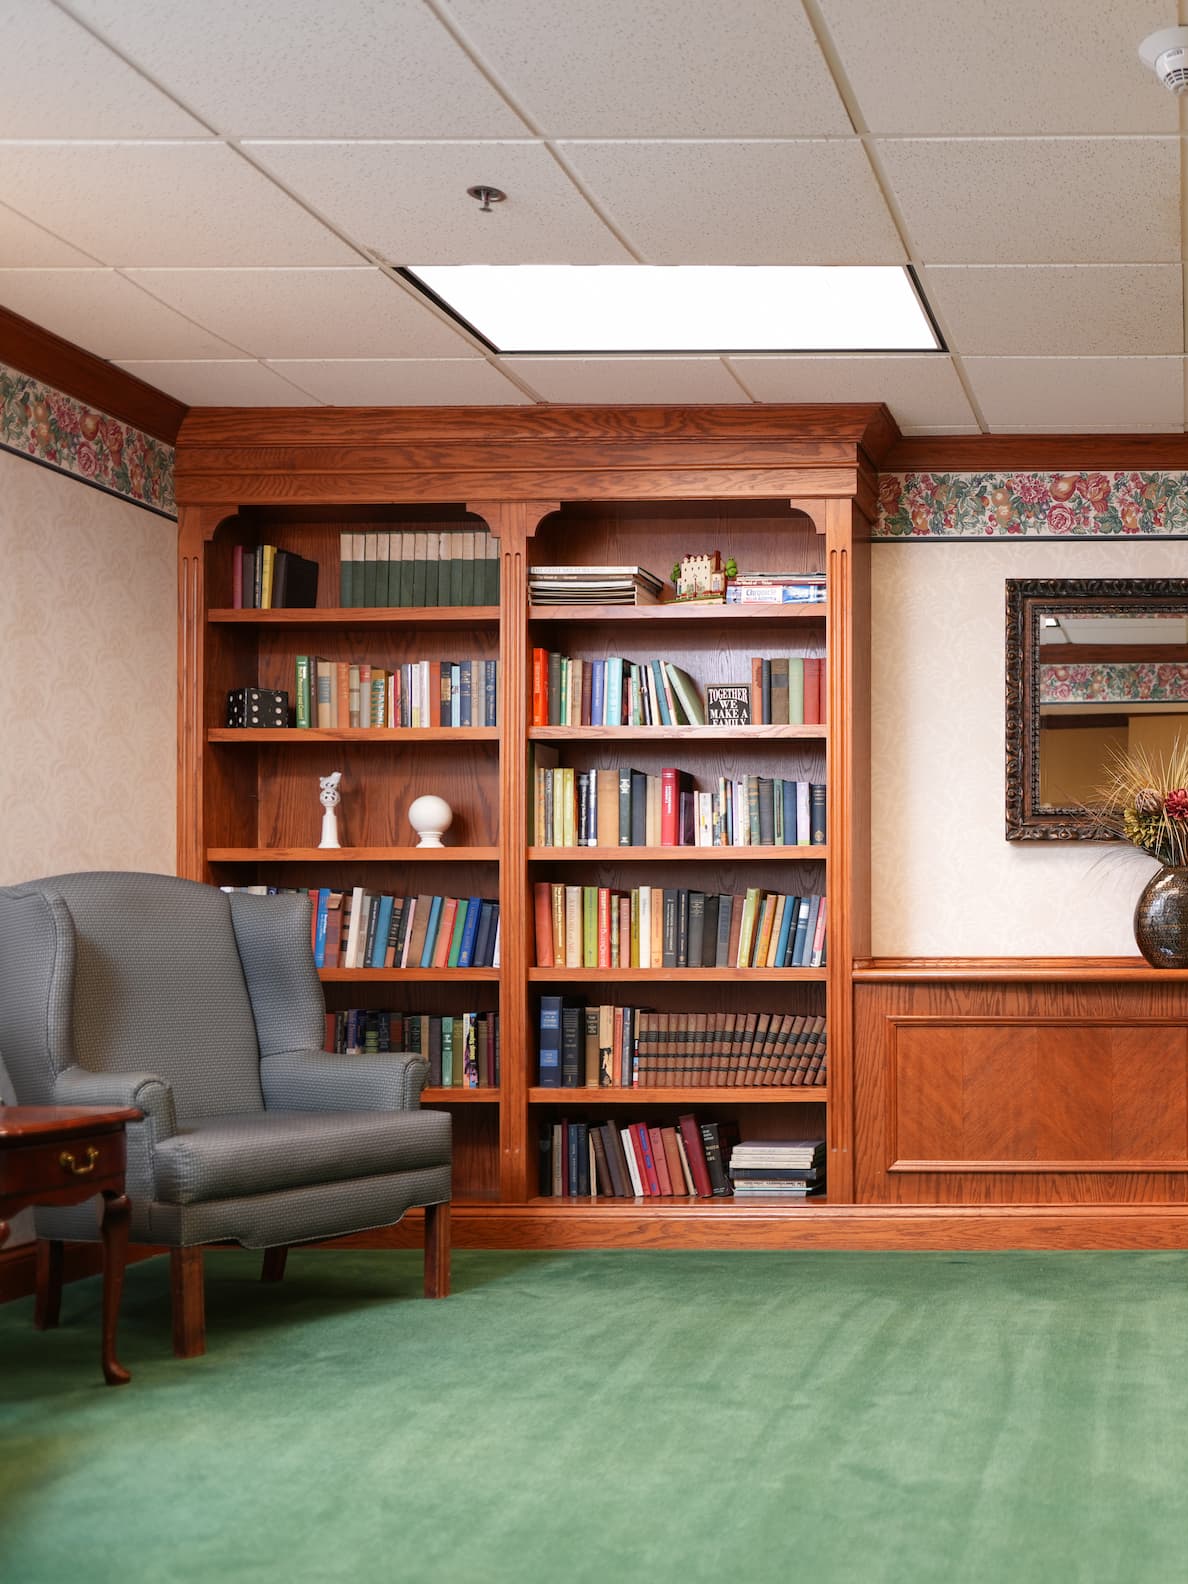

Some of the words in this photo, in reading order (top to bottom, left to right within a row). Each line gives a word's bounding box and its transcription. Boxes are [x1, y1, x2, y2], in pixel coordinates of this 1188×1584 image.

[708, 688, 748, 704] TOGETHER
[719, 700, 738, 709] WE
[710, 709, 739, 719] MAKE
[742, 709, 748, 719] A
